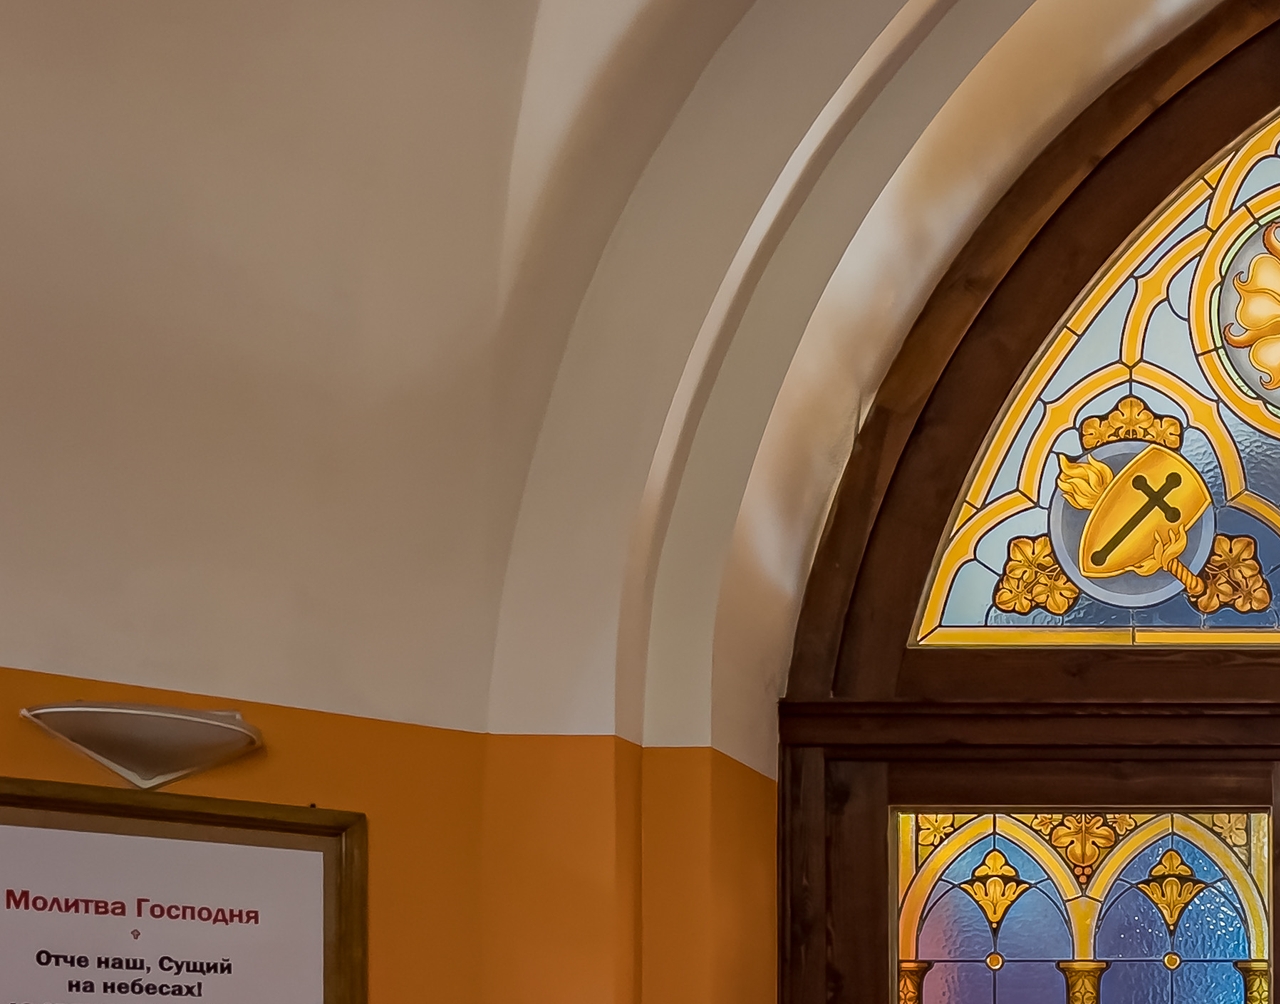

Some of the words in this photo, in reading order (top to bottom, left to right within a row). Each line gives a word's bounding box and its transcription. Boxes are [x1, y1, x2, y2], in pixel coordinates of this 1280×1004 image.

[5, 888, 127, 917] Молитва
[136, 897, 260, 926] Господня
[35, 949, 90, 969] Отче
[96, 956, 151, 974] наш,
[158, 955, 232, 976] Сущий
[67, 979, 95, 993] на
[102, 977, 203, 998] небесах!
